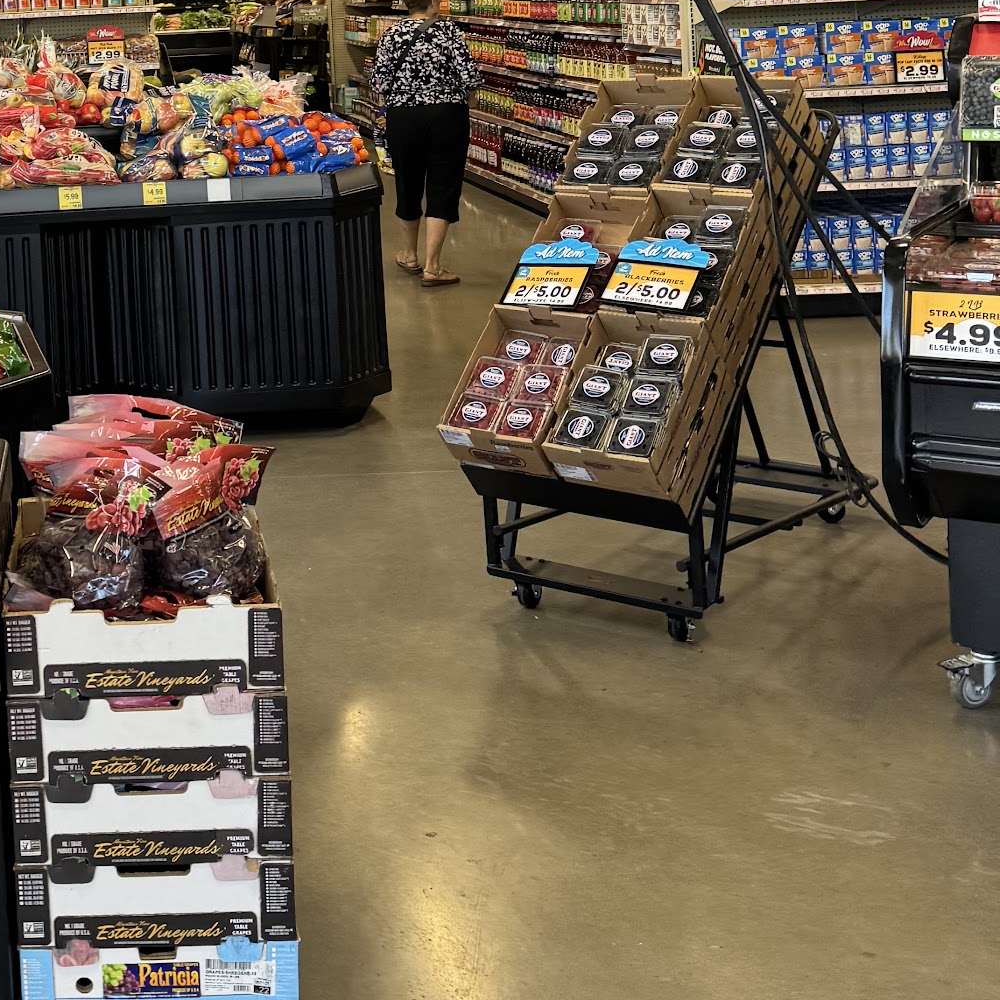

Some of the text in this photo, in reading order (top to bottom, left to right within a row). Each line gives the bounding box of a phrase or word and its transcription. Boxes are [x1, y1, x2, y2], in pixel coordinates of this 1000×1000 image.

[906, 36, 934, 48] Wow!
[900, 64, 939, 77] $2.99
[535, 246, 586, 259] Ad Item
[636, 243, 694, 261] Ad Item
[624, 273, 685, 286] BLACKBERRIES
[514, 284, 572, 298] 2/$5.00
[615, 280, 681, 300] 2/$5.00
[929, 343, 982, 354] ELSEWHERE:
[84, 672, 136, 689] Estate
[136, 668, 214, 693] Vineyards
[89, 755, 219, 780] Estate Vineyards
[93, 839, 223, 863] Estate Vineyards
[95, 921, 227, 945] Estate Vineyards
[137, 963, 200, 989] Patricia
